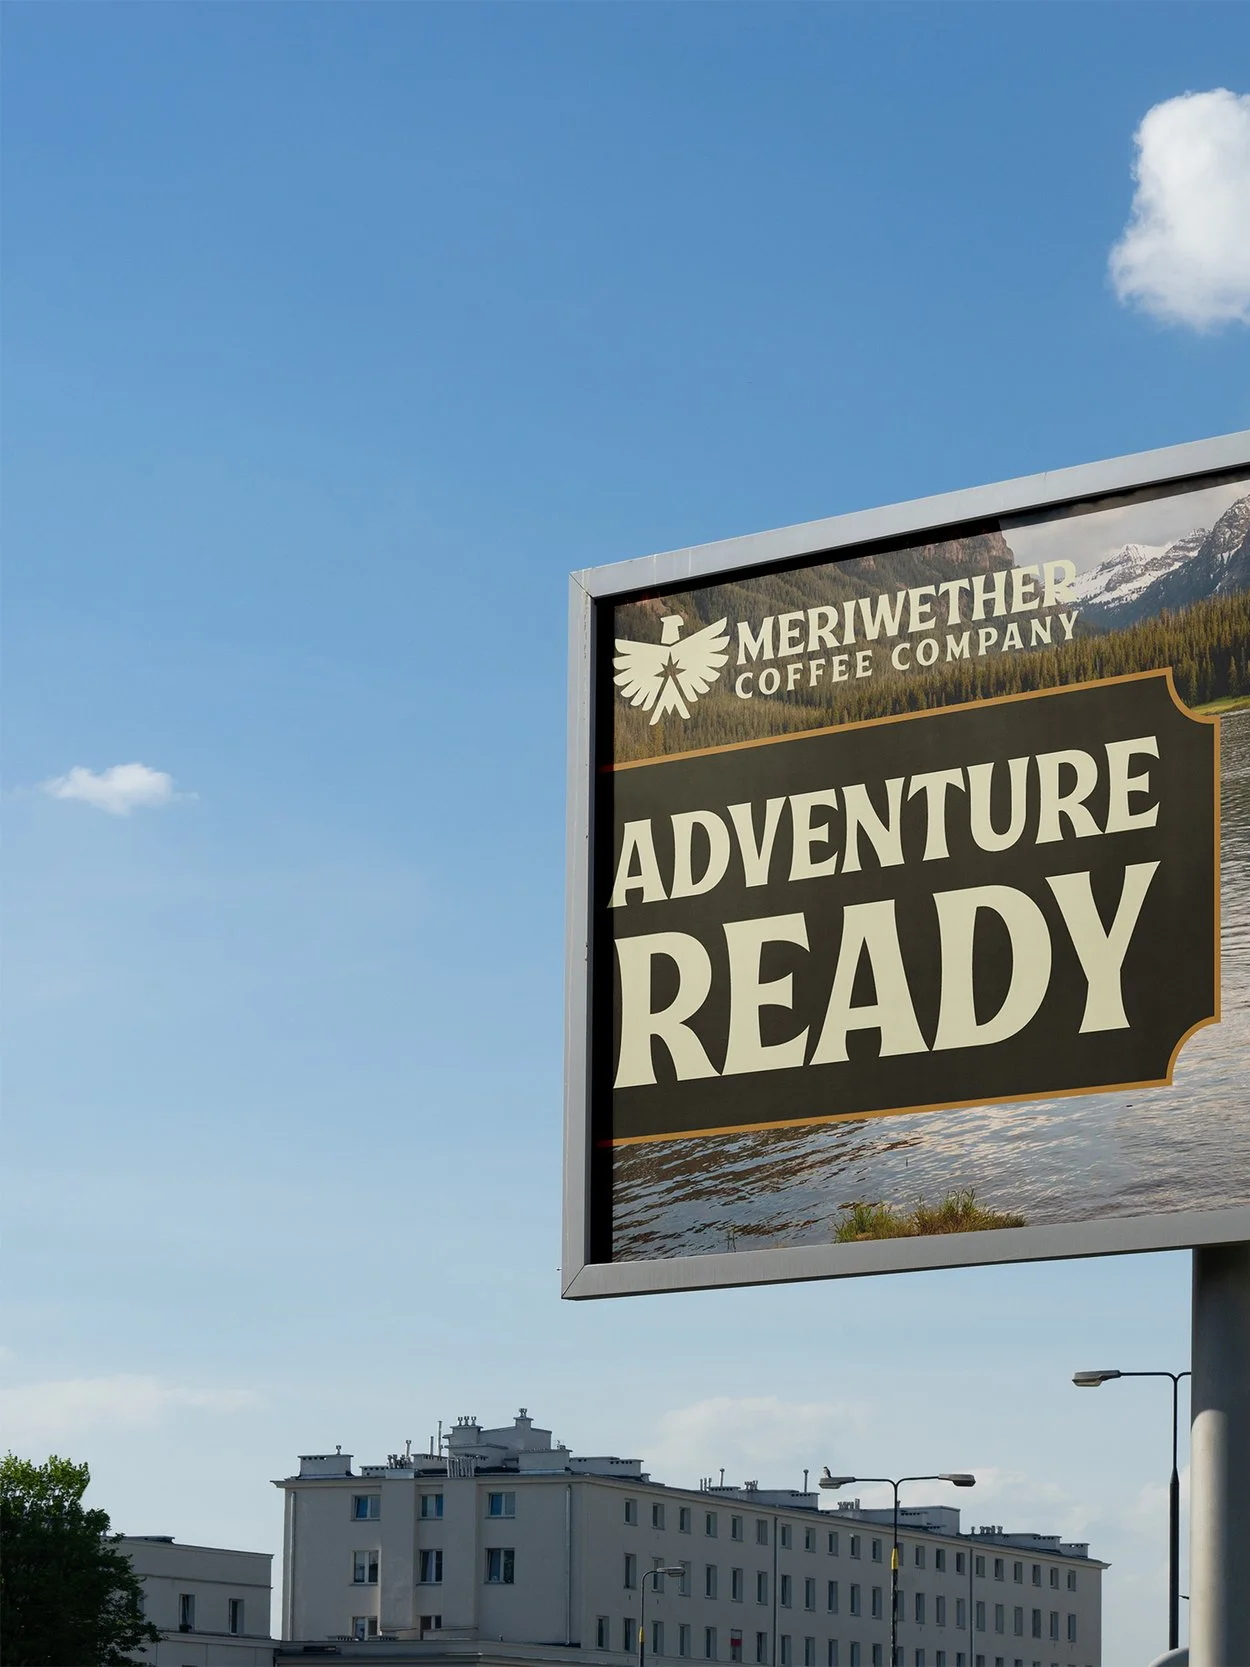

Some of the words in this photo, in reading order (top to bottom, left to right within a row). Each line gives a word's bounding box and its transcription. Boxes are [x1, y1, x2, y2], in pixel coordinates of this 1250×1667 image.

[735, 650, 873, 699] COFFEE
[891, 610, 1079, 671] COMPANY
[736, 559, 1077, 666] MERIWETHER
[607, 736, 1161, 908] ADVENTURE
[613, 860, 1161, 1089] READY
